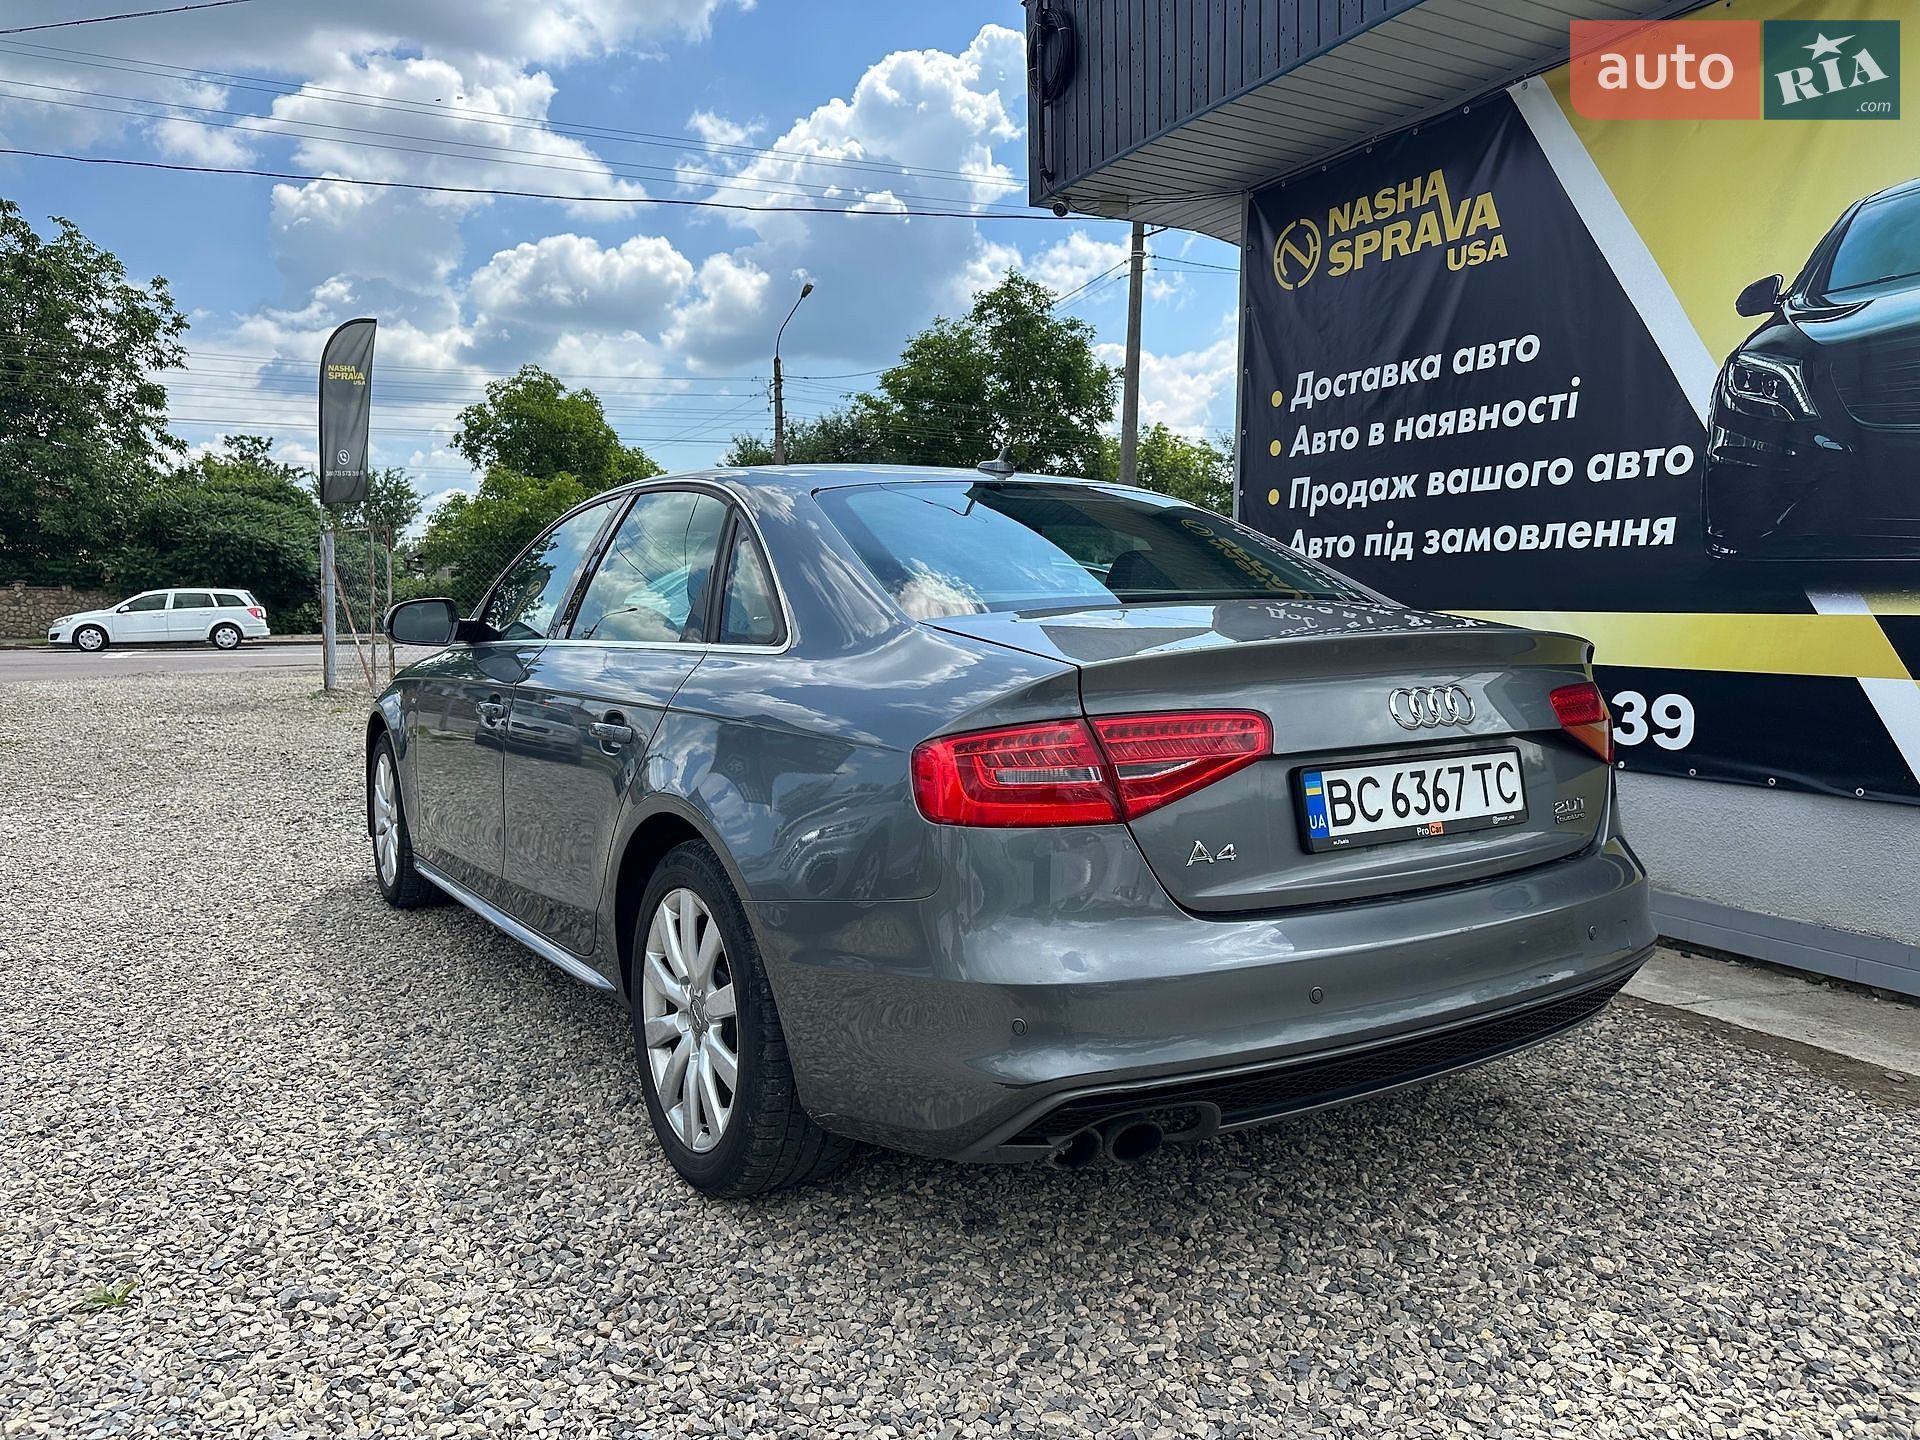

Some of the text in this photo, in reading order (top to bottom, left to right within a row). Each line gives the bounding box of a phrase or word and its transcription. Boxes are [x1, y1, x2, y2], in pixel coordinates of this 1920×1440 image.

[1328, 168, 1448, 237] NASHA
[1327, 191, 1501, 278] SPRAVA
[1446, 234, 1509, 272] USA
[327, 364, 356, 373] NASHA
[327, 371, 366, 381] SPRAVA
[1289, 334, 1541, 413] Доставка авто
[1288, 375, 1581, 458] Авто в наявності
[1288, 444, 1695, 517] Продаж вашого авто
[1289, 516, 1678, 562] Авто під замовлення
[1611, 690, 1695, 751] 39
[1309, 814, 1327, 830] UA
[1326, 761, 1518, 828] BC 6367 TC
[1185, 840, 1237, 867] A4
